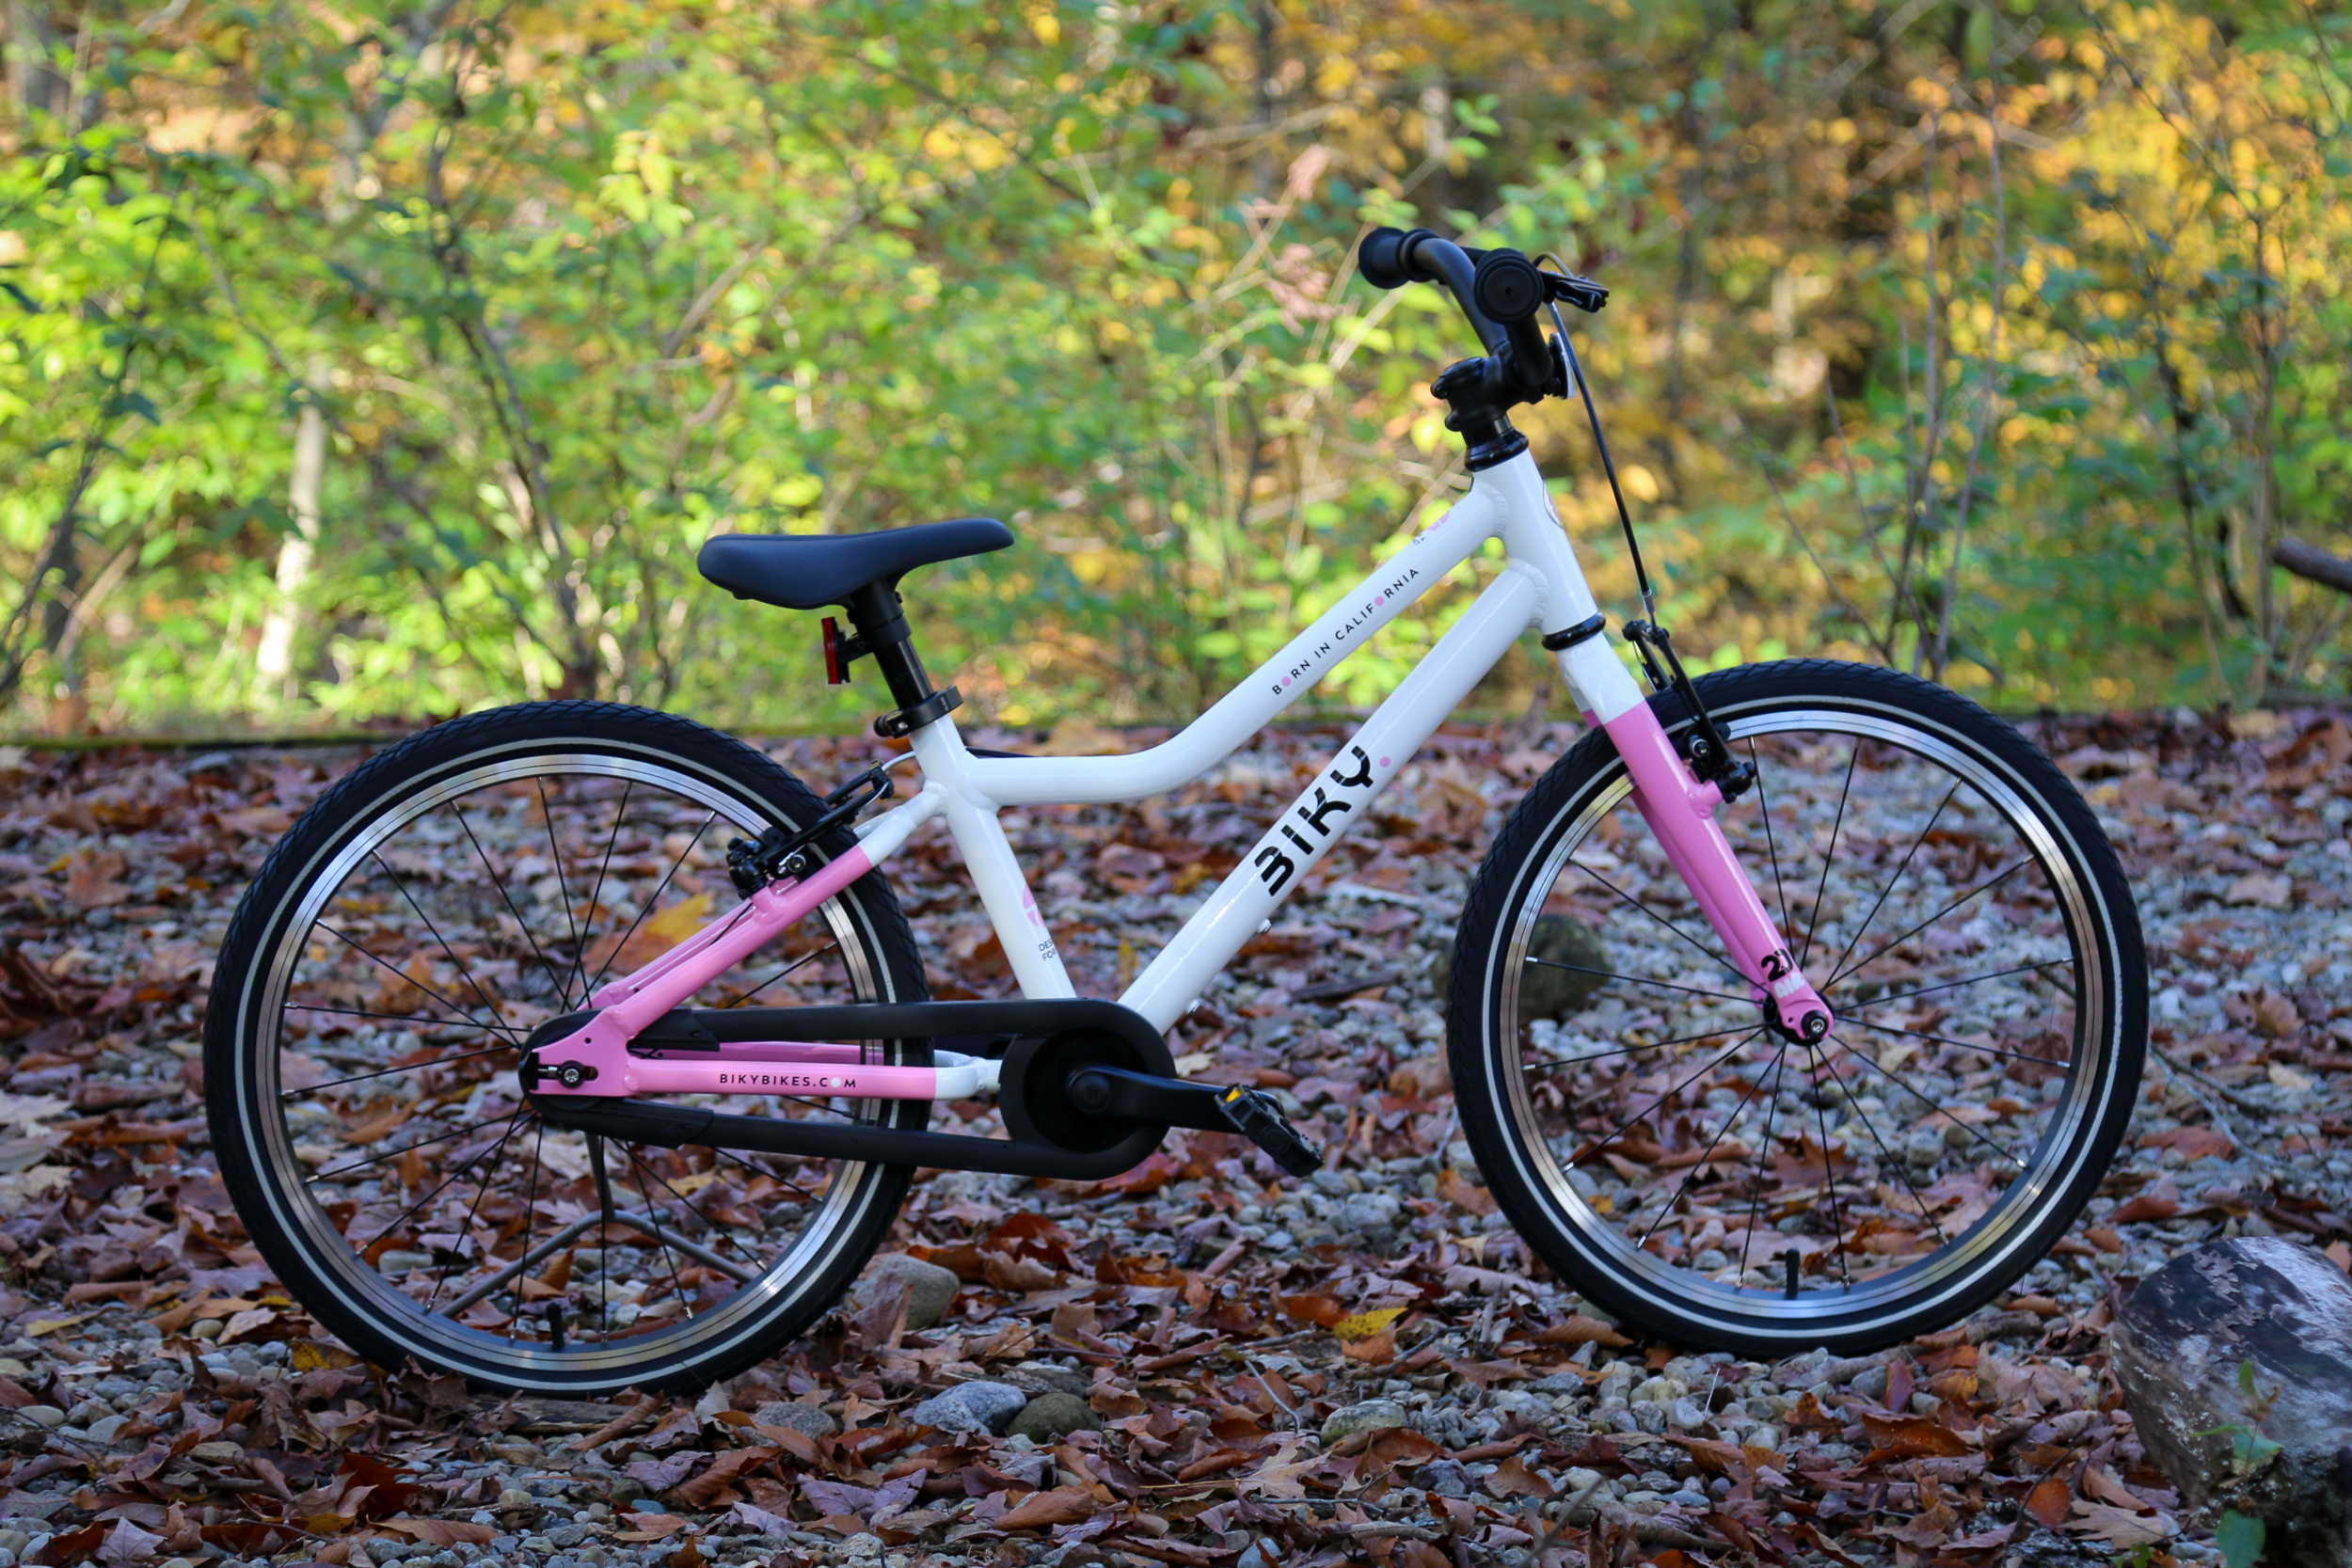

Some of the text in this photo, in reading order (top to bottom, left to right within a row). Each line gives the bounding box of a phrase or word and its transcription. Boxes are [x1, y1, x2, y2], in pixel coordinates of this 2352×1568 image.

[1272, 568, 1420, 695] BORN IN CALIFORNIA
[720, 1073, 856, 1088] BIKYBIKES.COM
